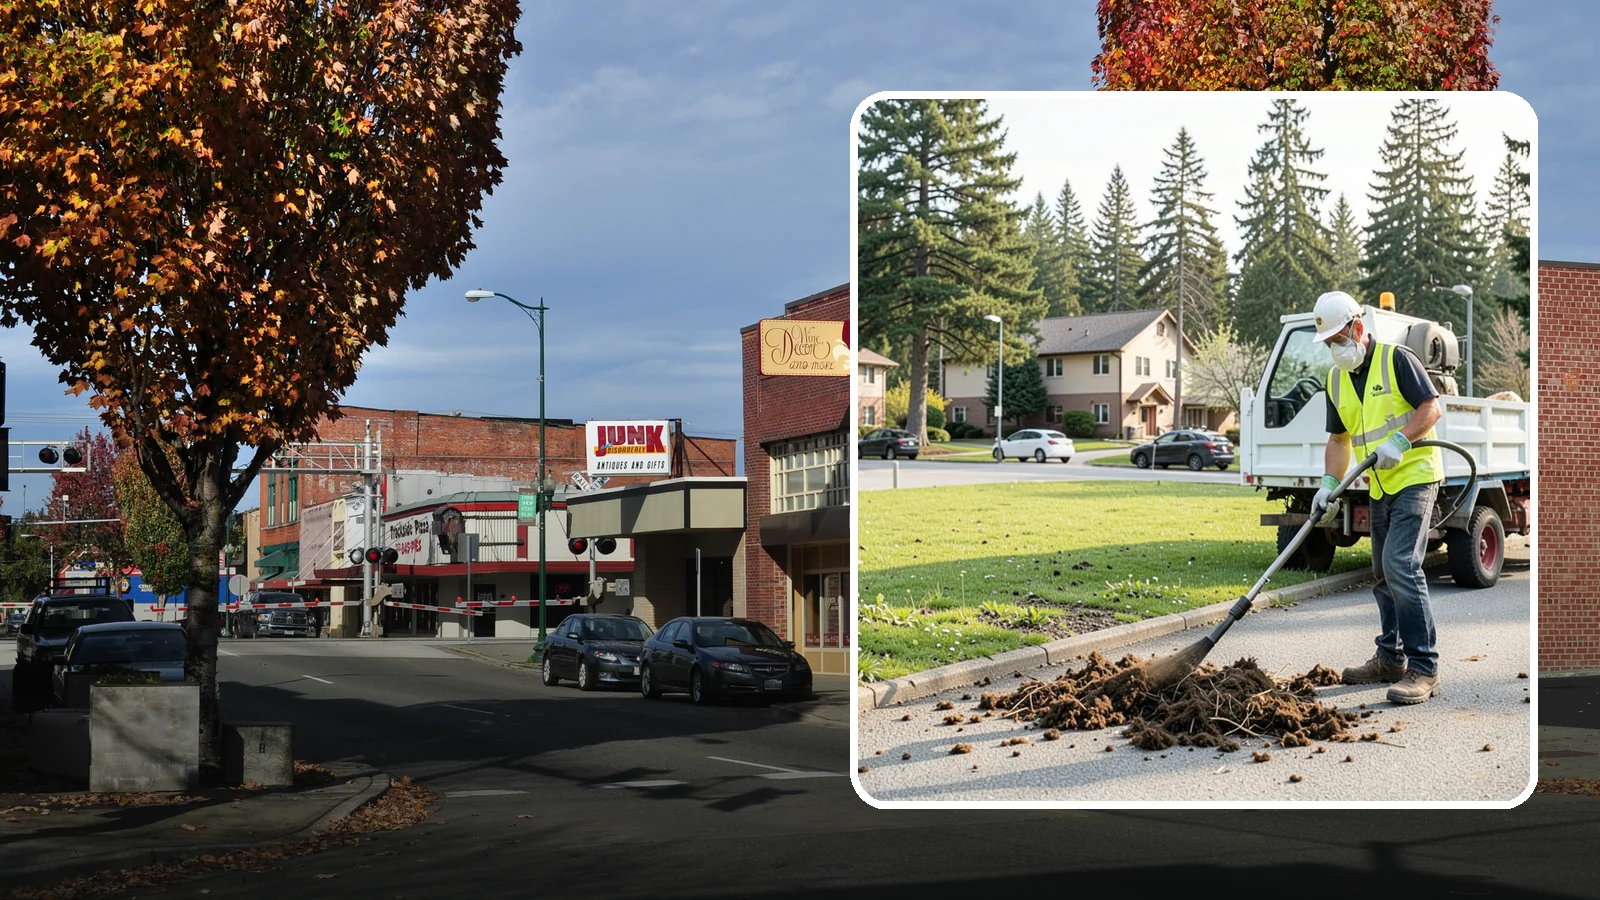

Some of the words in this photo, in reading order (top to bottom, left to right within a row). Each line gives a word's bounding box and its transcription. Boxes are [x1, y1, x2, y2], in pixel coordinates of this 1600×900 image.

[595, 424, 665, 457] JUNK
[607, 445, 646, 454] DISORDERLY
[597, 461, 628, 470] ANTIQUES
[631, 461, 644, 470] AND
[647, 460, 665, 470] GIFTS
[414, 519, 429, 534] Pizza
